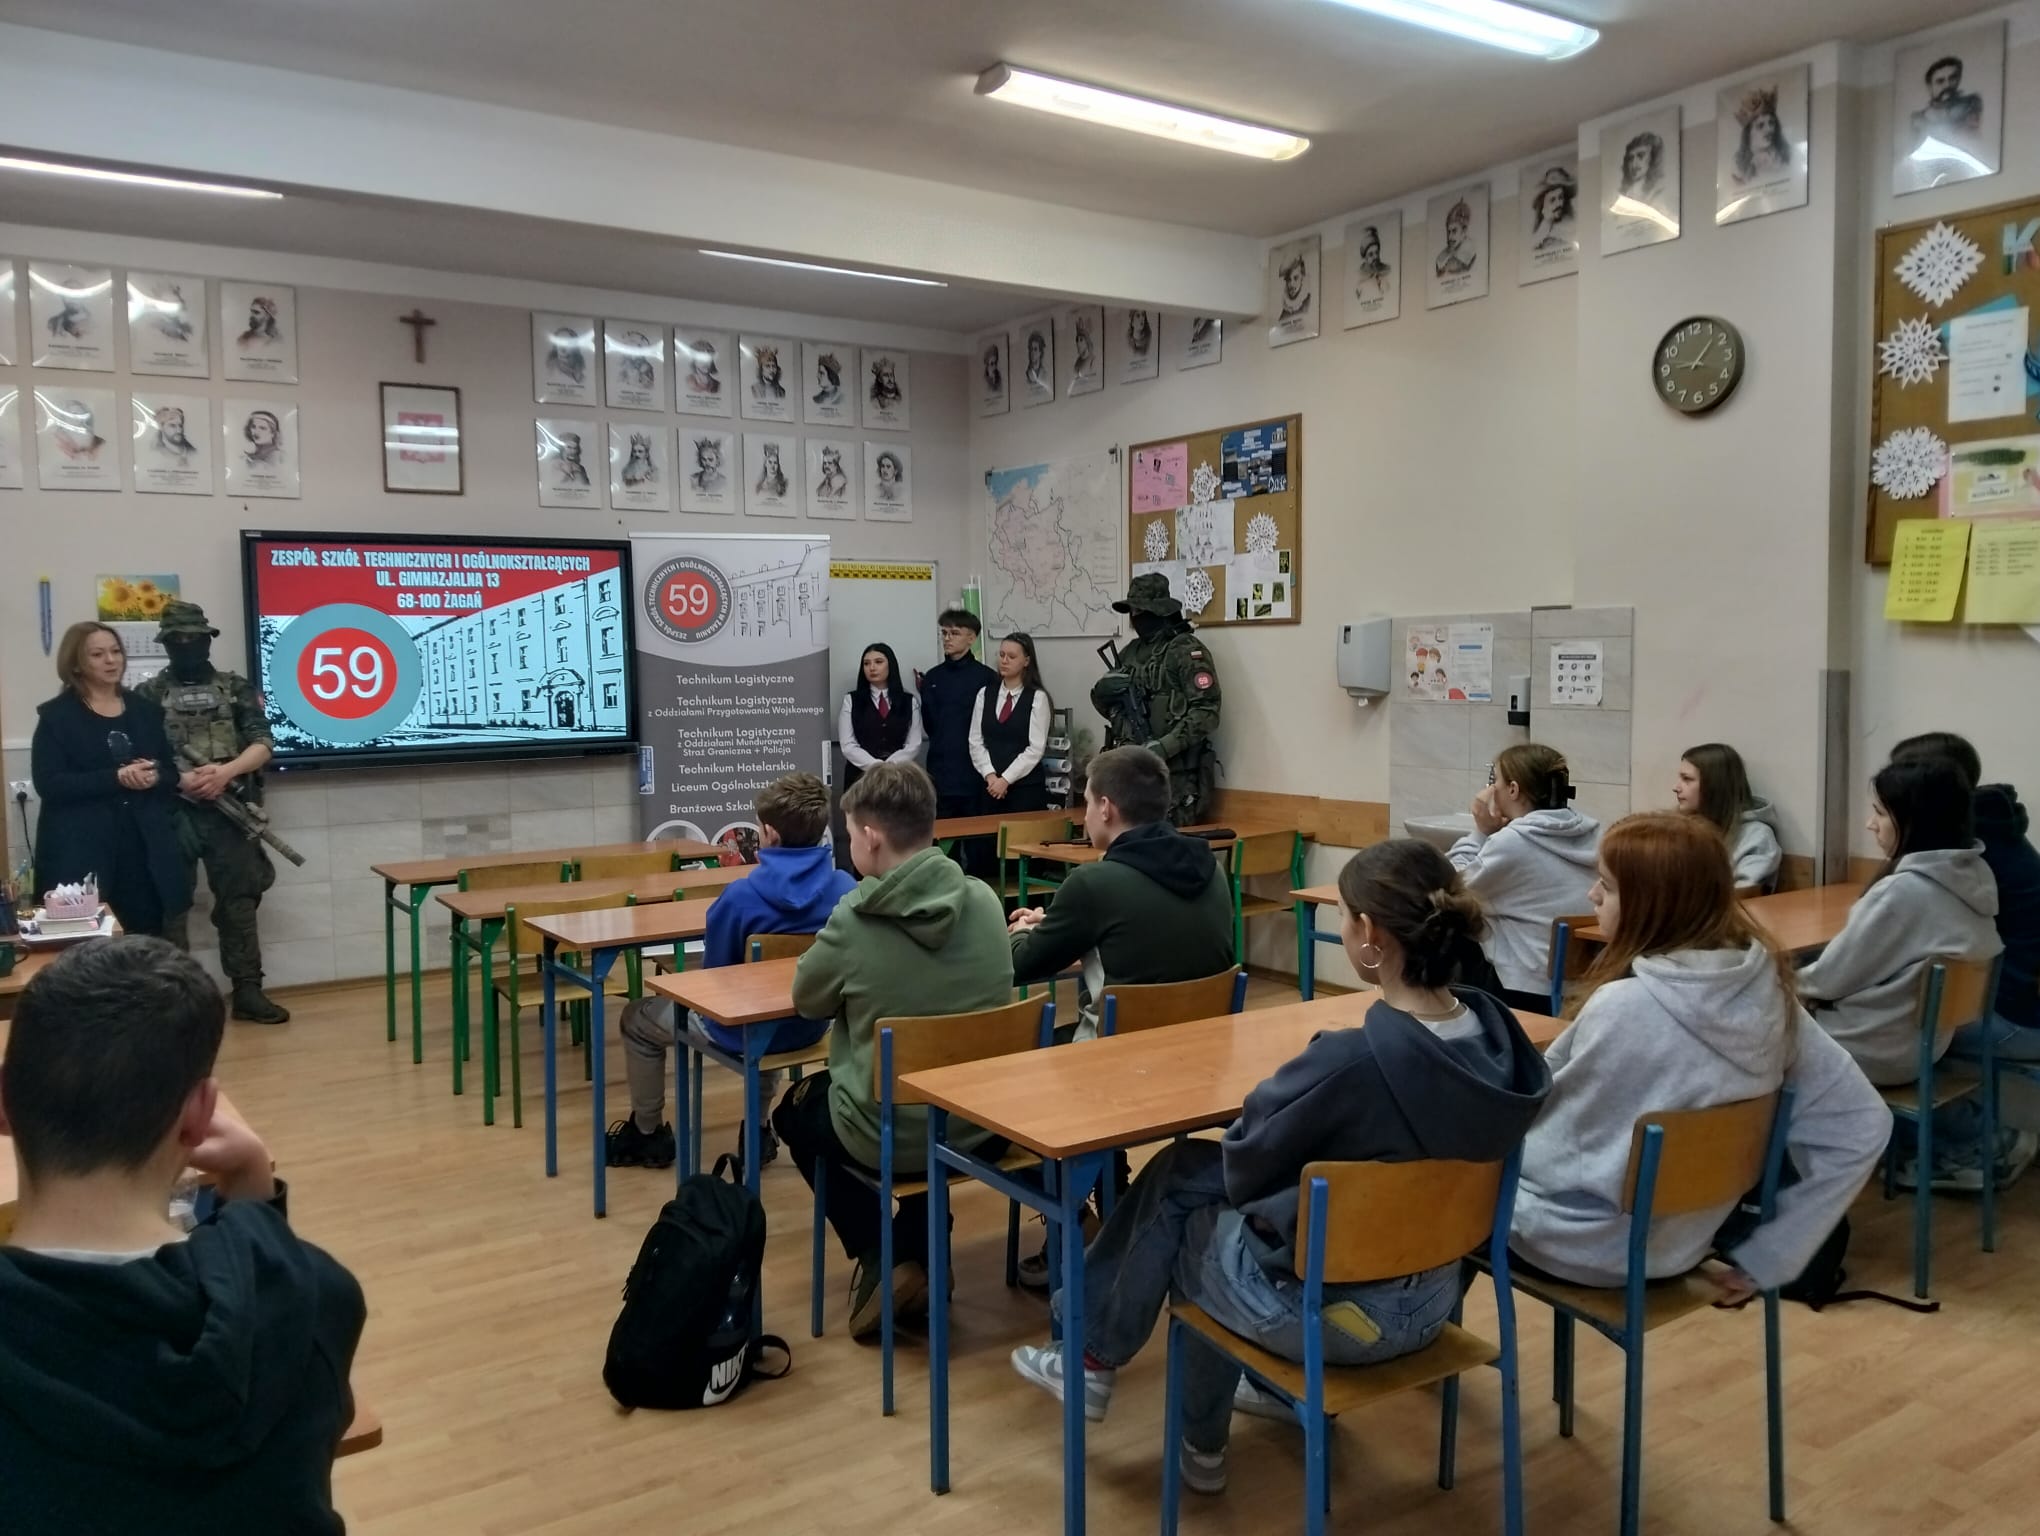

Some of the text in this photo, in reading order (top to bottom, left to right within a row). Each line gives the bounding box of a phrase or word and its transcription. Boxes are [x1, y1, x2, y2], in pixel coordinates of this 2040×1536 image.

[1687, 322, 1701, 336] 12
[1675, 330, 1685, 342] 11
[1717, 332, 1727, 346] 2
[1665, 345, 1678, 359] 10
[1724, 348, 1733, 361] 3
[1661, 364, 1671, 377] 9
[1720, 367, 1729, 379] 4
[1666, 380, 1676, 392] 8
[1709, 382, 1718, 396] 5
[1678, 389, 1687, 402] 7
[1693, 391, 1704, 404] 6
[271, 547, 590, 574] ZESPÓŁ SZKÓŁ TECHNICZNYCH I OGÓLNOKSZTAŁCĄCYCH
[376, 570, 500, 588] UL. GIMNAZJALNA 13
[397, 590, 483, 609] 68-100 ŻAGAŃ
[669, 584, 708, 616] 59
[312, 646, 383, 700] 59
[676, 674, 794, 686] Technikum Logistyczne
[677, 695, 795, 708] Technikum Logistyczne
[707, 707, 770, 718] Przygotowania
[772, 706, 824, 716] Wojskowego
[678, 727, 796, 740] Technikum Logistyczne
[708, 747, 752, 756] Graniczna
[763, 746, 791, 756] Policja
[679, 760, 796, 775] Technikum Hotelarskie
[671, 782, 708, 792] Liceum
[670, 801, 723, 814] Branżowa
